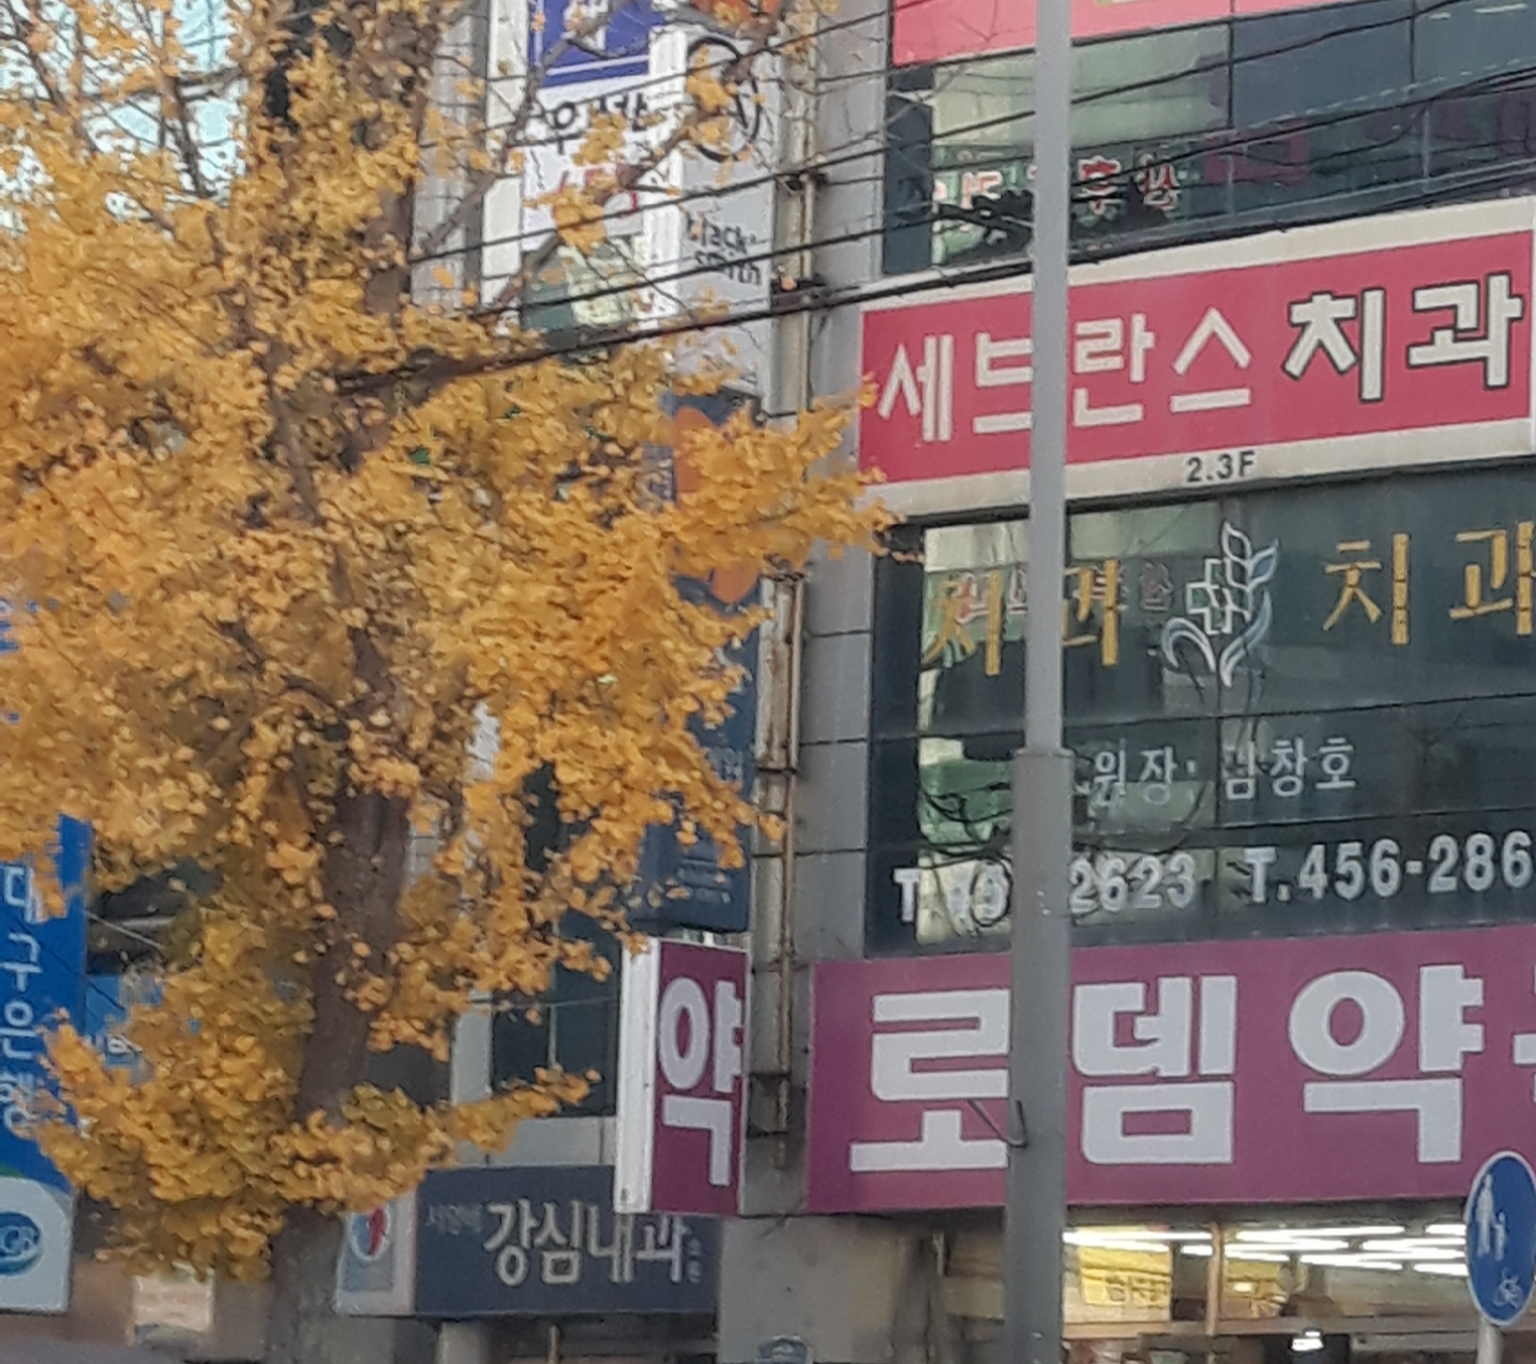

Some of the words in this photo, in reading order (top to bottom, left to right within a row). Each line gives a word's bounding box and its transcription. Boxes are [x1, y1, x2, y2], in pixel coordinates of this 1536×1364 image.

[877, 306, 1252, 442] 세브란스
[1282, 269, 1525, 404] 치과
[1186, 448, 1257, 485] 2.3F
[658, 975, 744, 1187] 약
[484, 1197, 693, 1286] 강심내과
